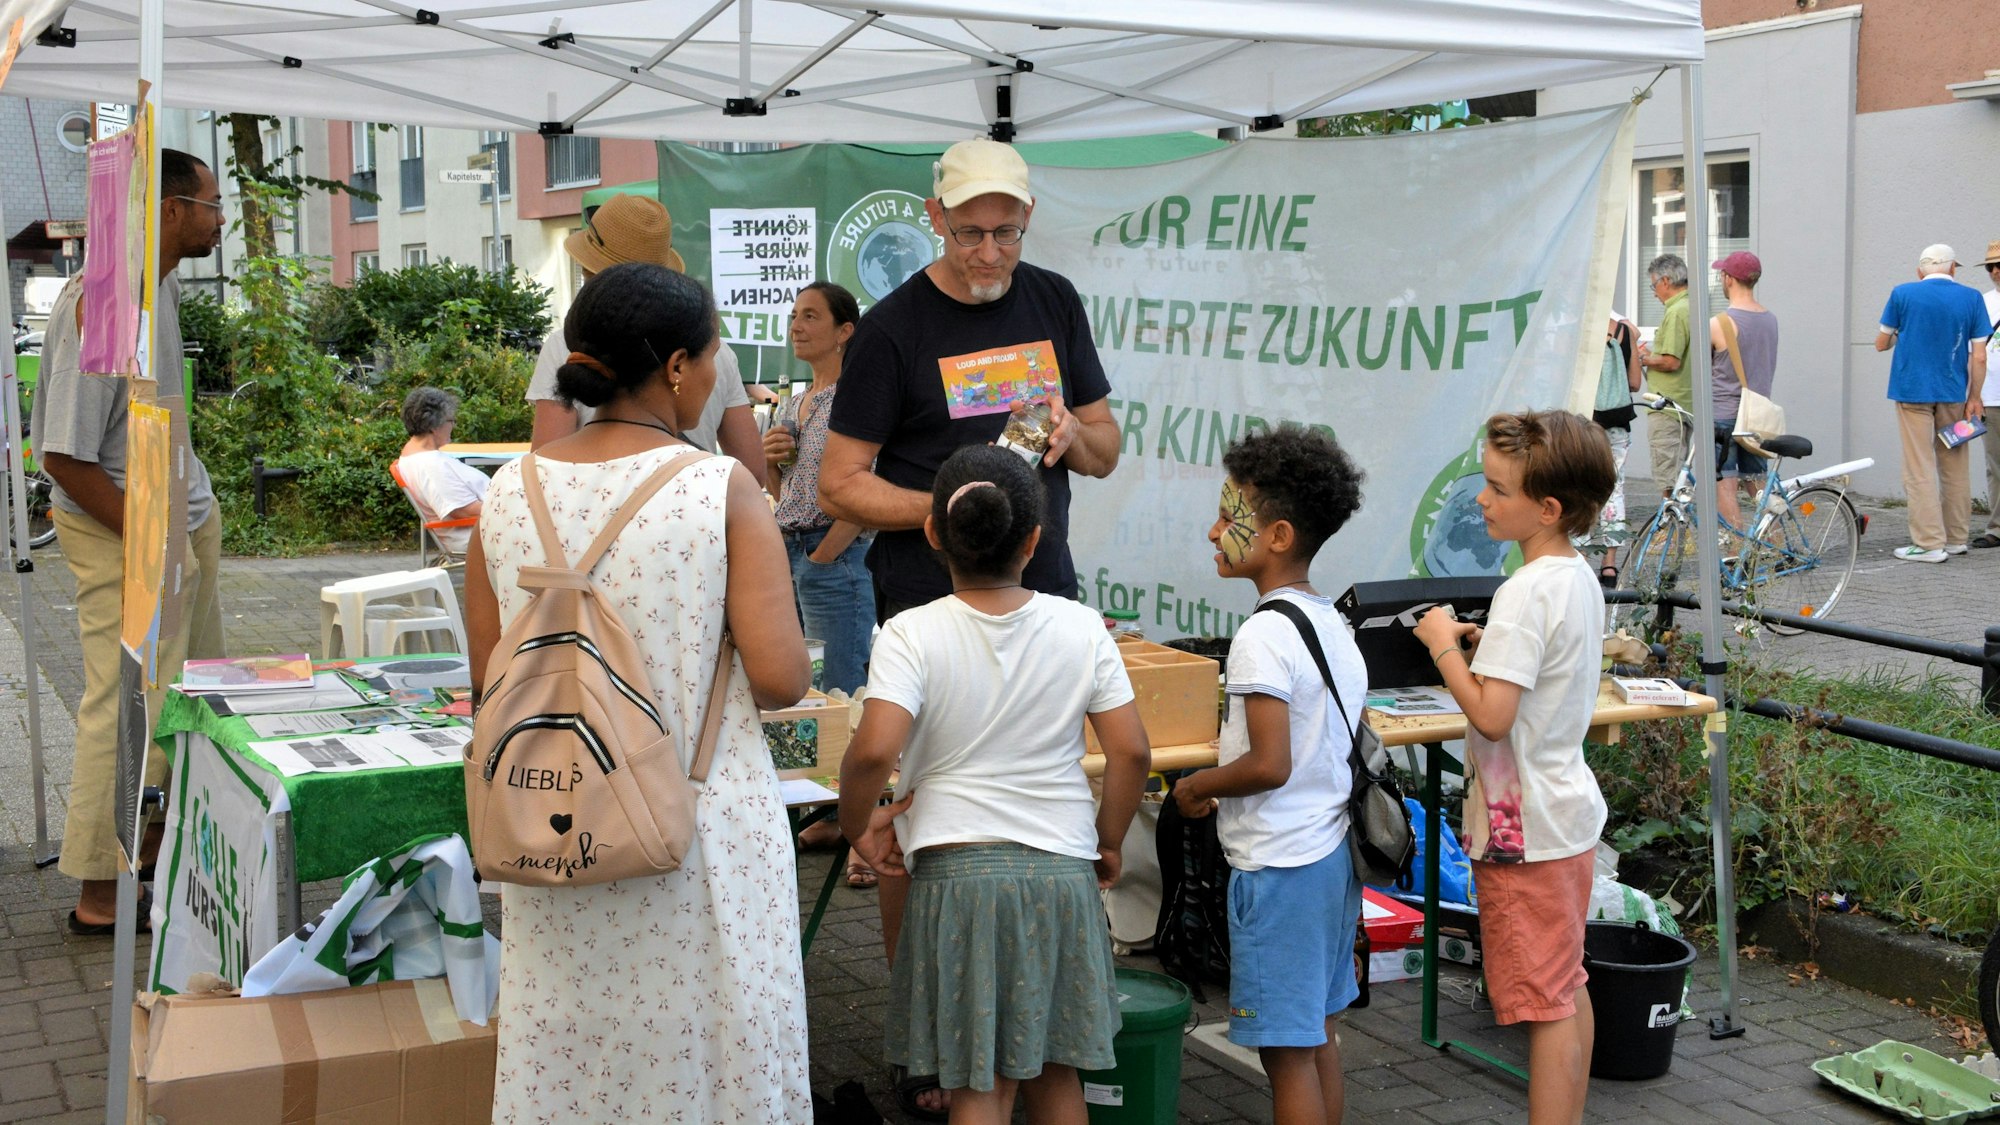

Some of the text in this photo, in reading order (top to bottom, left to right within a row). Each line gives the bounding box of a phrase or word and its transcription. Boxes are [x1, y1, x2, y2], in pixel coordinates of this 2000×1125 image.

[447, 172, 484, 182] Kapitelstr.
[1205, 194, 1316, 252] EINE
[1257, 289, 1544, 371] ZUKUNFT
[955, 351, 1018, 371] LOUD AND PROUD!
[1095, 567, 1146, 611] for
